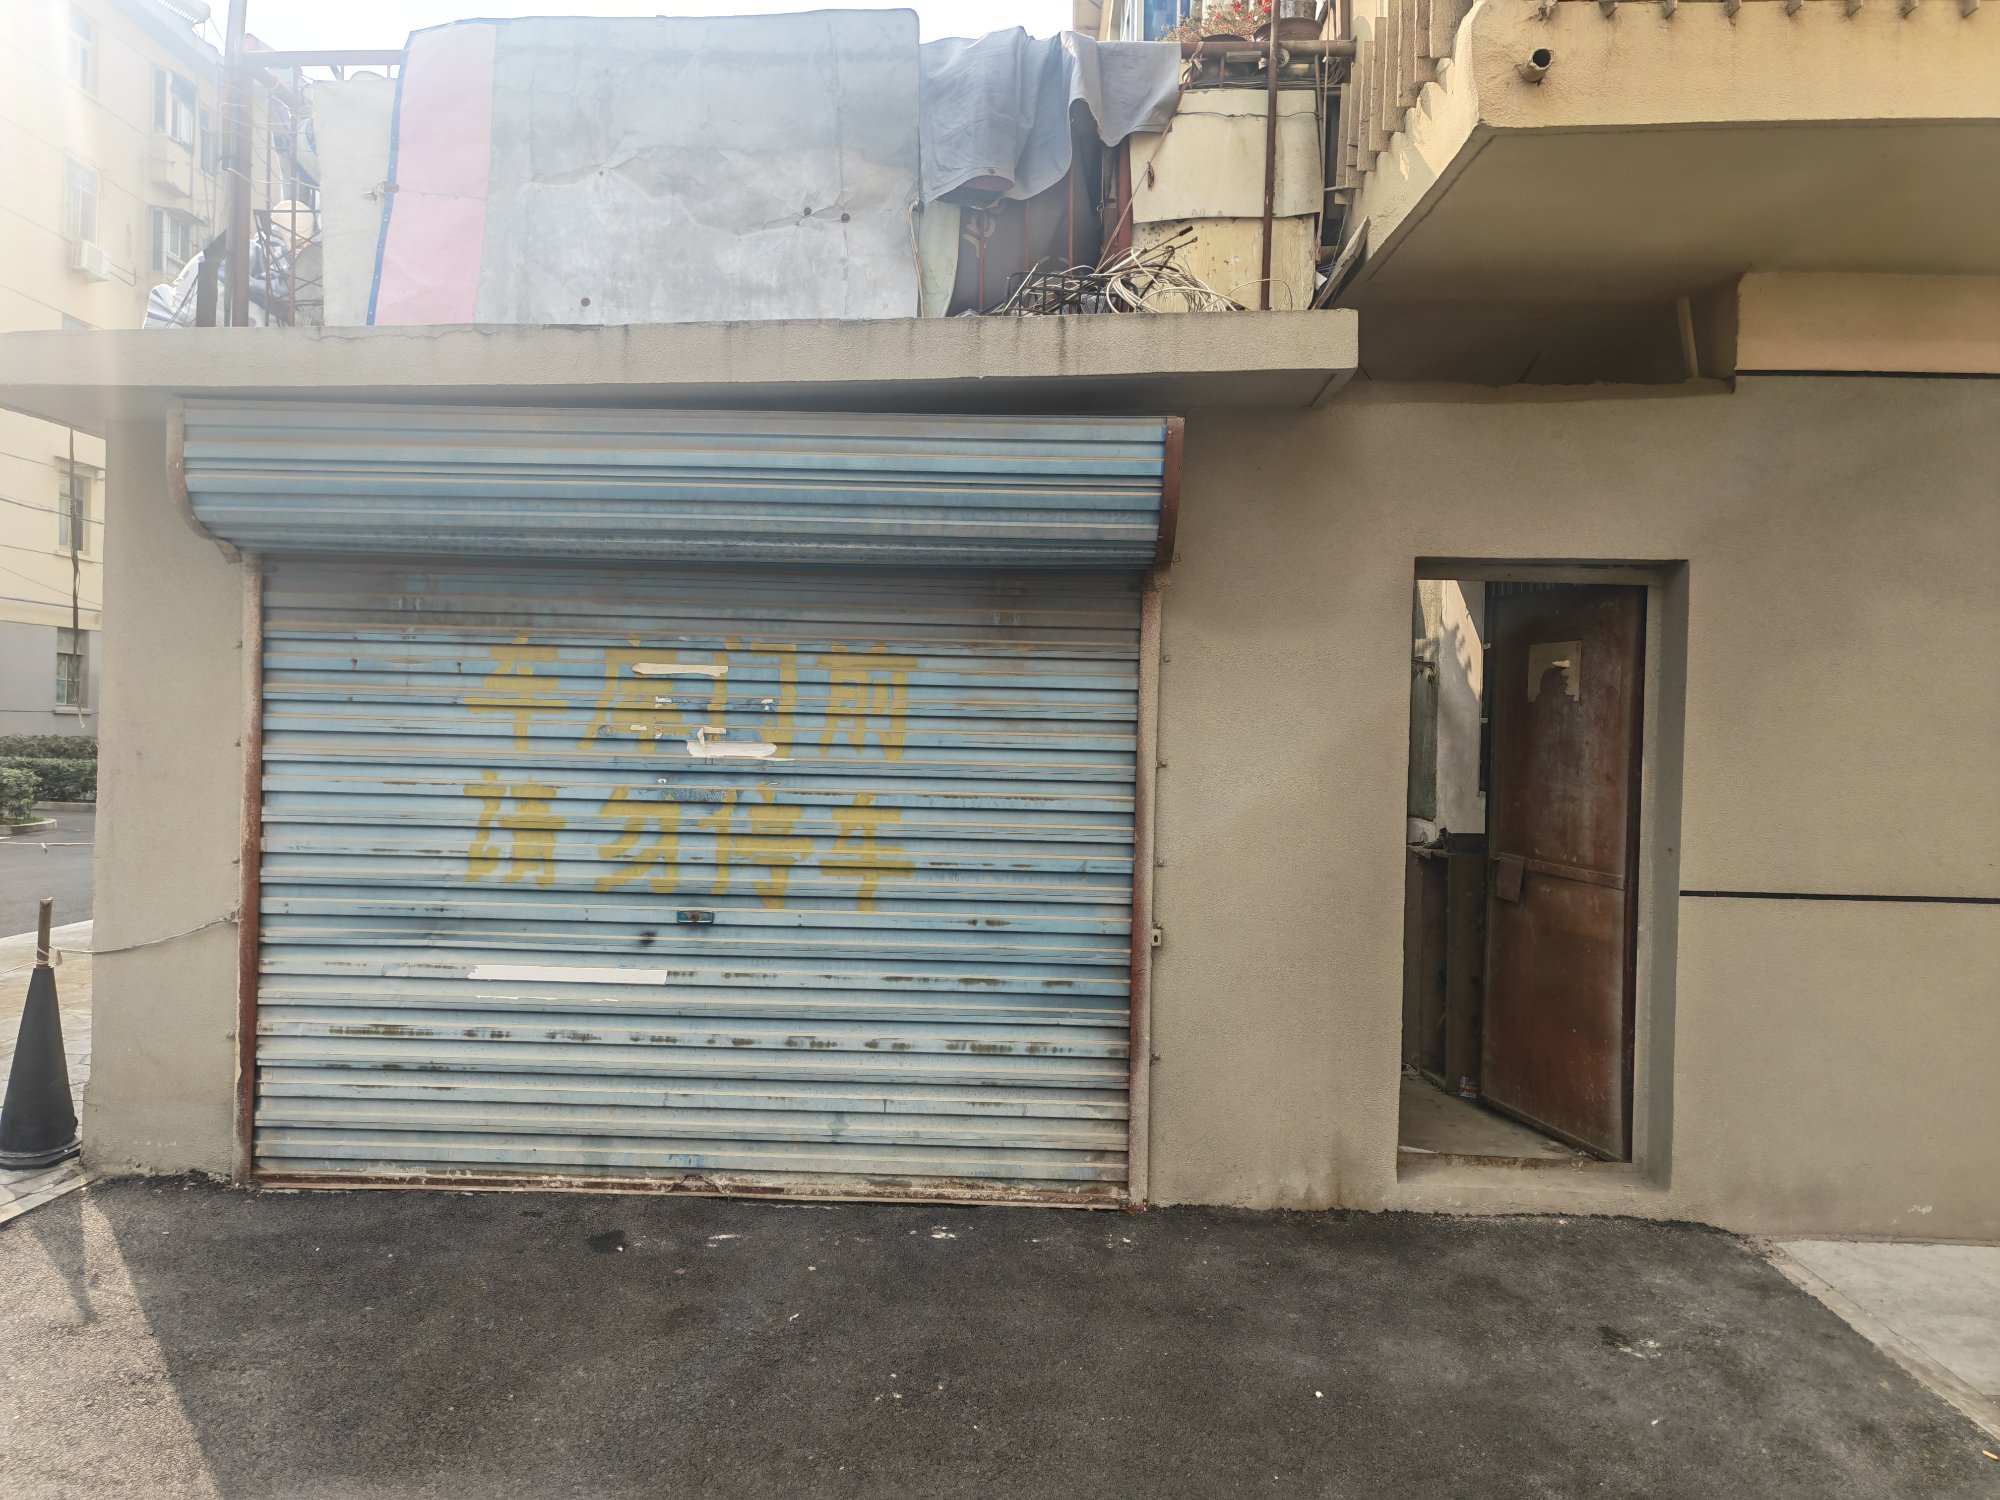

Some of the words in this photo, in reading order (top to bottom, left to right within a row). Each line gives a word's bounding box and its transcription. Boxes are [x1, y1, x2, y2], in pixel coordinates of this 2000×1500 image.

[464, 632, 919, 762] 车库门前
[463, 771, 915, 912] 请勿停车
